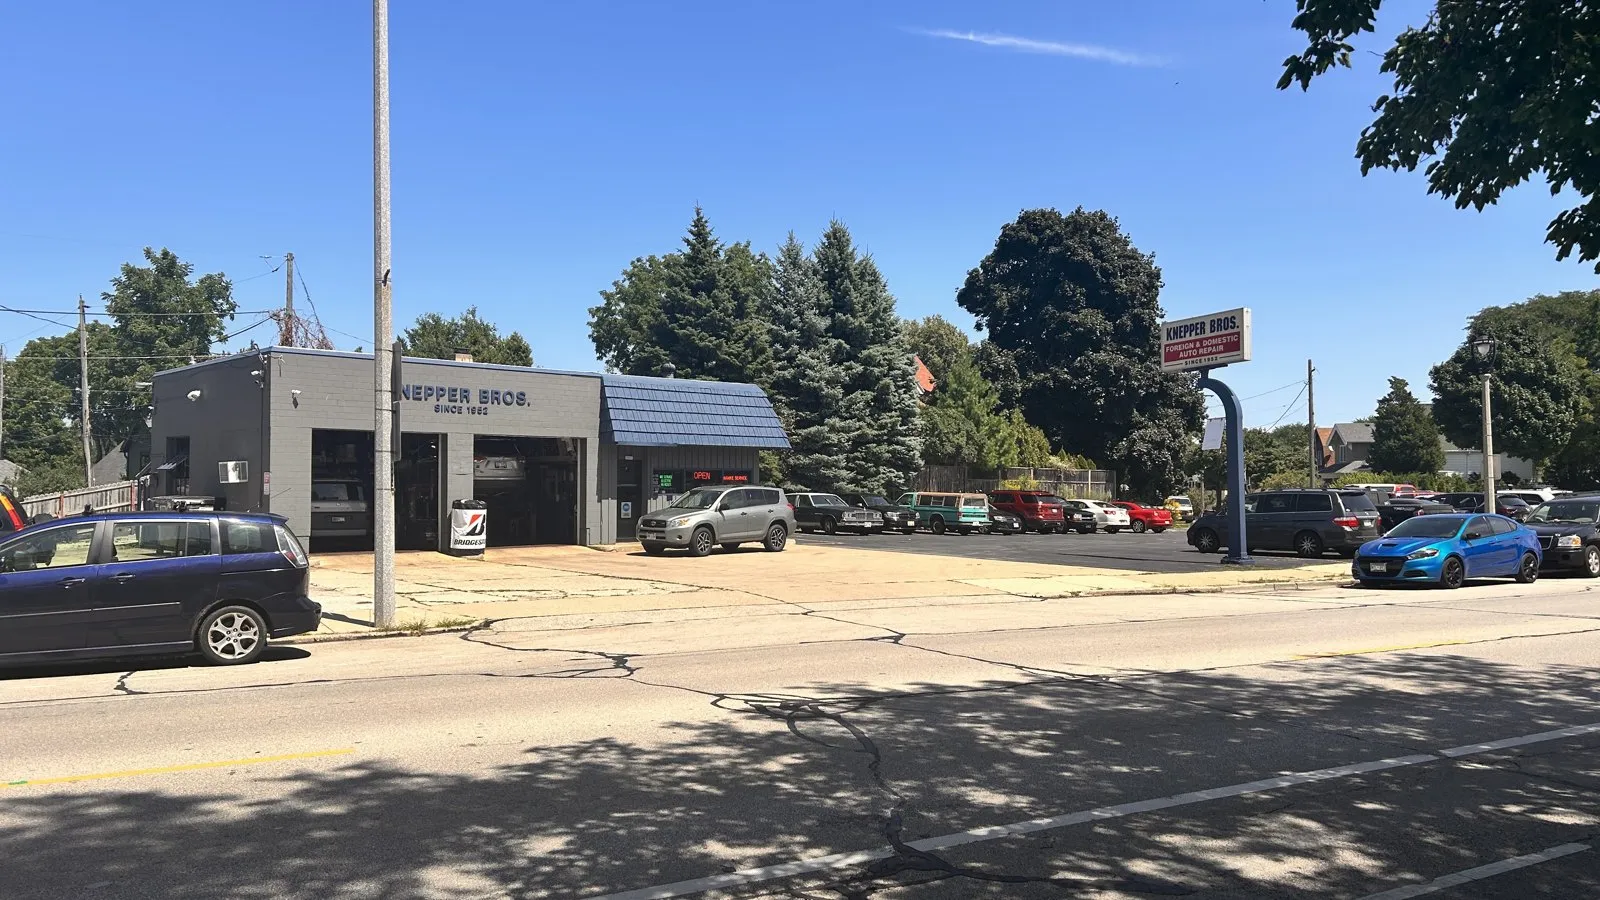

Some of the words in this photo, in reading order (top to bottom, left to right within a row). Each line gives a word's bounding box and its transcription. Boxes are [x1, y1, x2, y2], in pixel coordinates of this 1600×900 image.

[1166, 321, 1206, 341] KNEPPER
[1210, 315, 1239, 333] BROS.
[1166, 342, 1194, 352] FOREIGN
[1202, 335, 1239, 346] DOMESTIC
[1179, 350, 1197, 358] AUTO
[1199, 345, 1224, 354] REPAIR
[401, 384, 470, 403] NEPPER
[479, 389, 530, 407] BROS.
[434, 404, 463, 414] SINCE
[694, 471, 711, 480] OPEN
